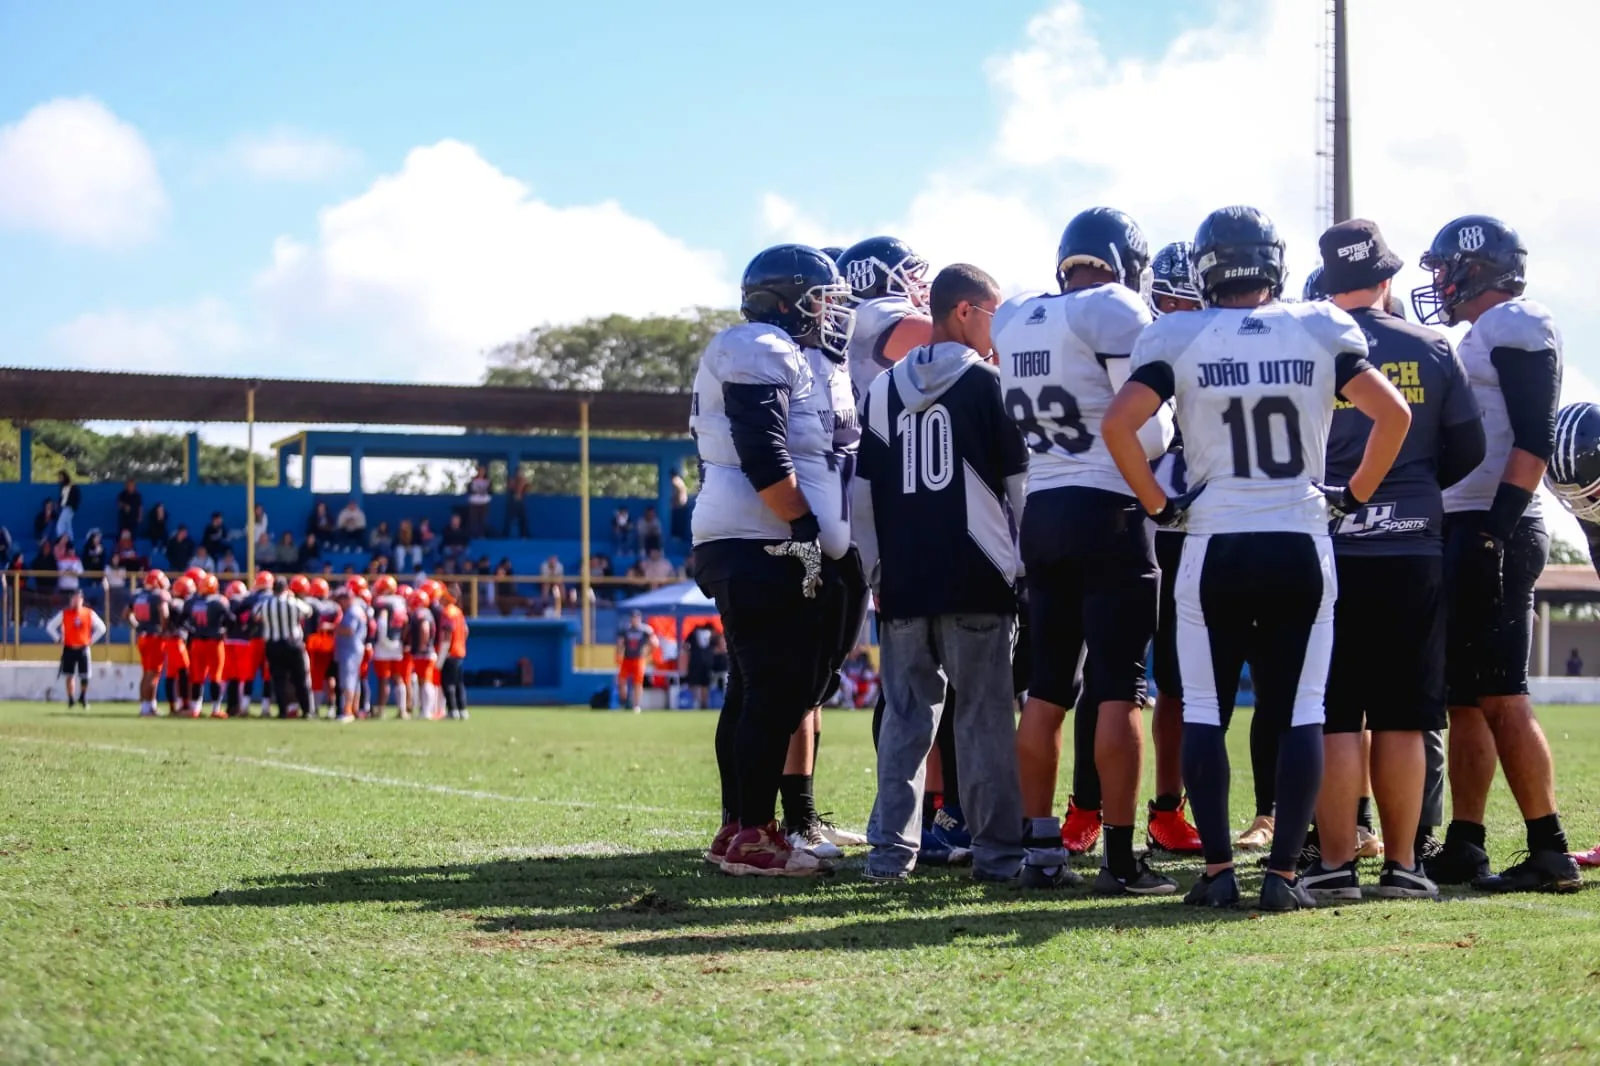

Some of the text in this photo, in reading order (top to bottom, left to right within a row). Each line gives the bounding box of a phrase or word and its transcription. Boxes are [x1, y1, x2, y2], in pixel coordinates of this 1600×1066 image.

[1012, 350, 1051, 378] TIAGO
[1197, 357, 1250, 388] JOÃO
[897, 403, 953, 494] 10
[1005, 384, 1095, 454] 83
[1222, 394, 1305, 479] 10
